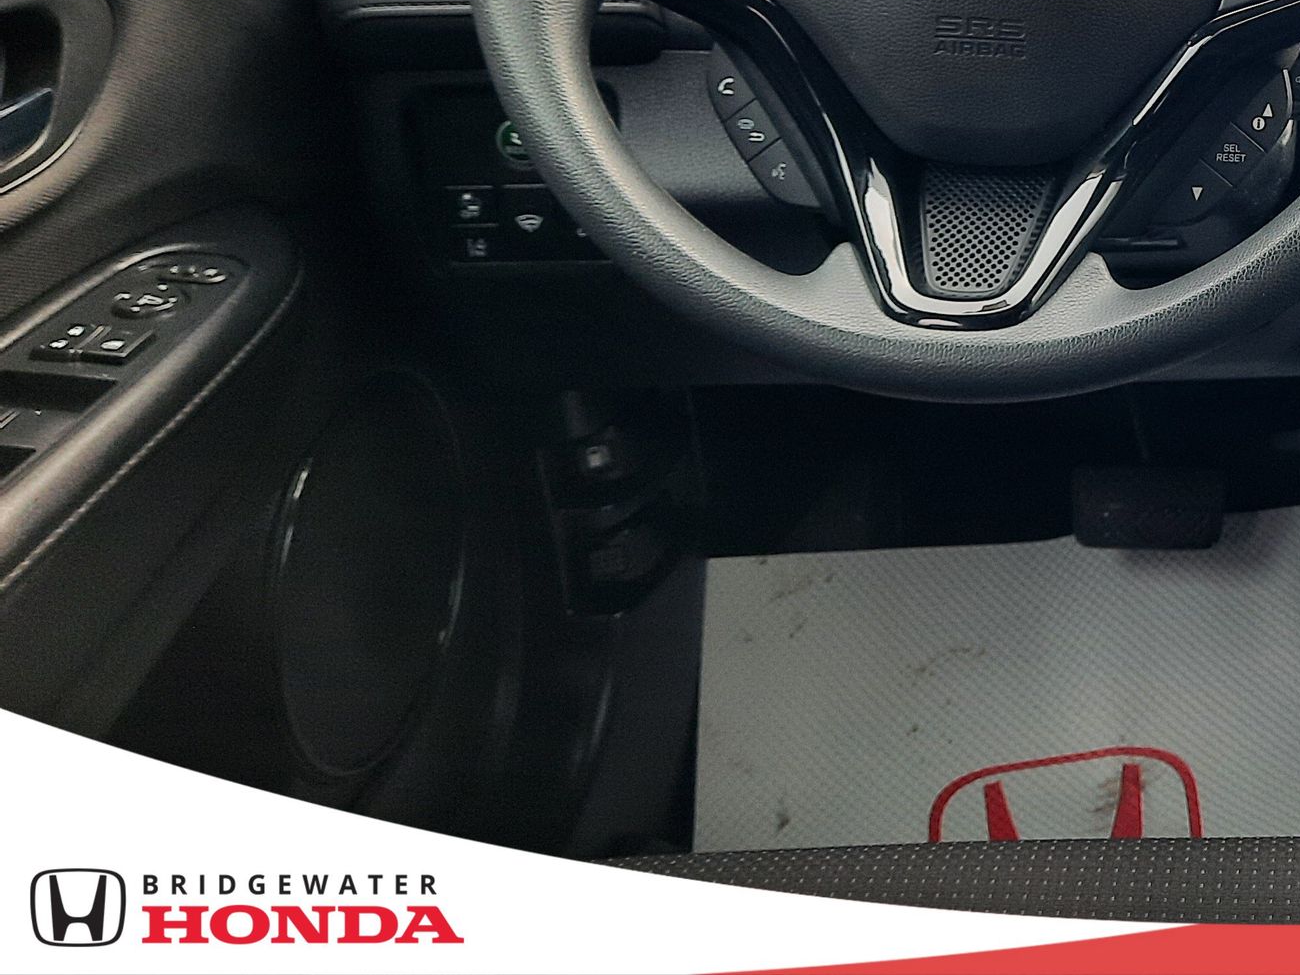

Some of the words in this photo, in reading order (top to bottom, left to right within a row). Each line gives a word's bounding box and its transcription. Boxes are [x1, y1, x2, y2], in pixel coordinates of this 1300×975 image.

[935, 16, 1026, 39] SRS
[933, 40, 1027, 59] AIRBAG
[1223, 143, 1241, 153] SEL
[1216, 153, 1247, 163] RESET
